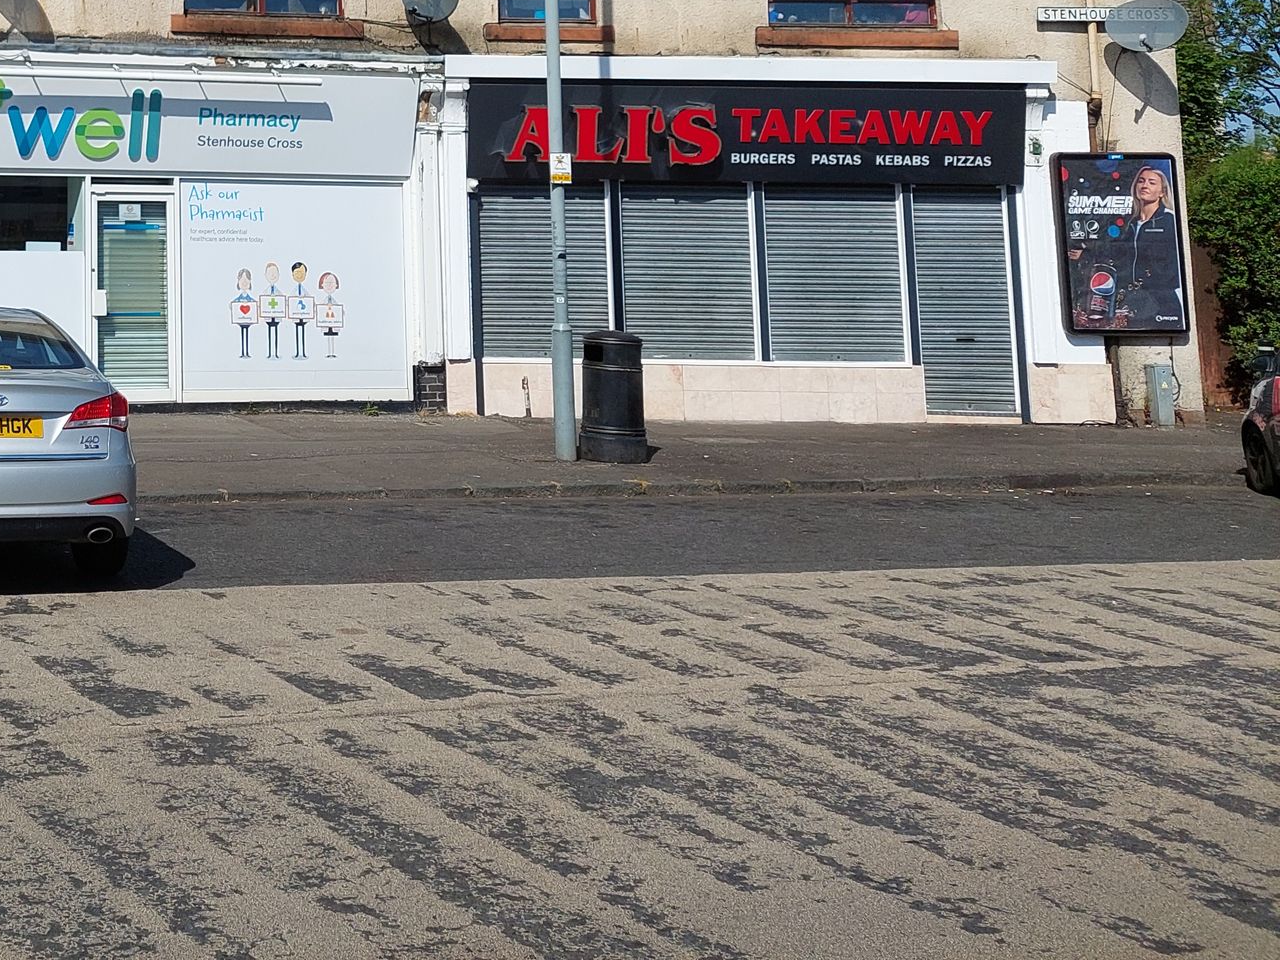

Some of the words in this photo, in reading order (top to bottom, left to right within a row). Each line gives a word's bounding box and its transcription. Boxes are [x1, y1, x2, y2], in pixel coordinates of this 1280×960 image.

[1044, 9, 1125, 20] STENHOUSE
[1127, 9, 1168, 20] CROSS
[7, 88, 163, 163] well
[197, 107, 302, 132] Pharmacy
[197, 135, 265, 148] Stenhouse
[267, 137, 303, 150] Cross
[505, 104, 722, 167] ALI'S
[732, 108, 993, 146] TAKEAWAY
[730, 152, 796, 165] BURGERS
[811, 153, 862, 166] PASTAS
[875, 154, 930, 167] KEBABS
[944, 155, 992, 167] PIZZAS
[188, 182, 212, 201] Ask
[218, 191, 239, 200] our
[1068, 195, 1134, 208] SUMMER
[189, 203, 264, 222] Pharmacist
[1068, 207, 1092, 215] GAME
[1093, 207, 1132, 215] CHANGER
[0, 417, 33, 434] HGK
